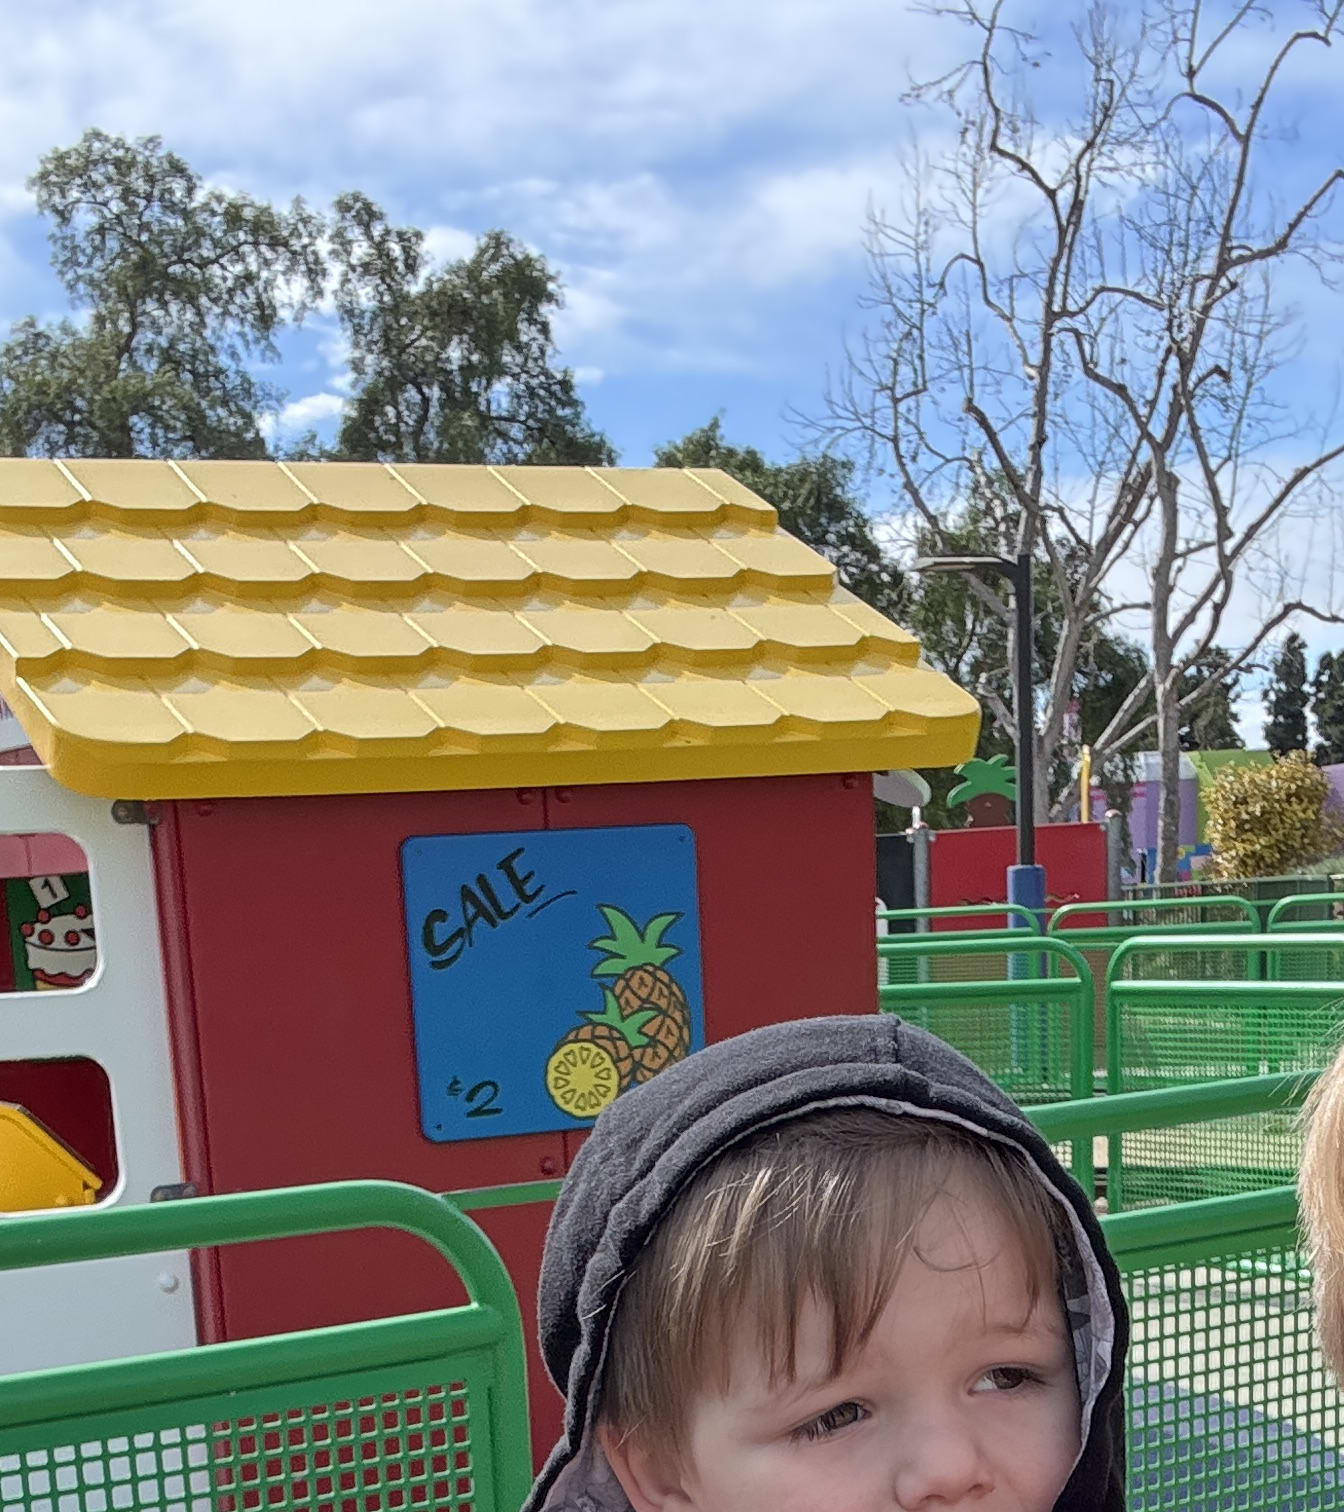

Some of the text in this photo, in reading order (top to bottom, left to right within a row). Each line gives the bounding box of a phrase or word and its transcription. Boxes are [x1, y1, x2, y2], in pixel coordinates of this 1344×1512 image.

[41, 878, 57, 899] 1
[422, 848, 545, 957] SALE
[447, 1076, 503, 1118] $2
